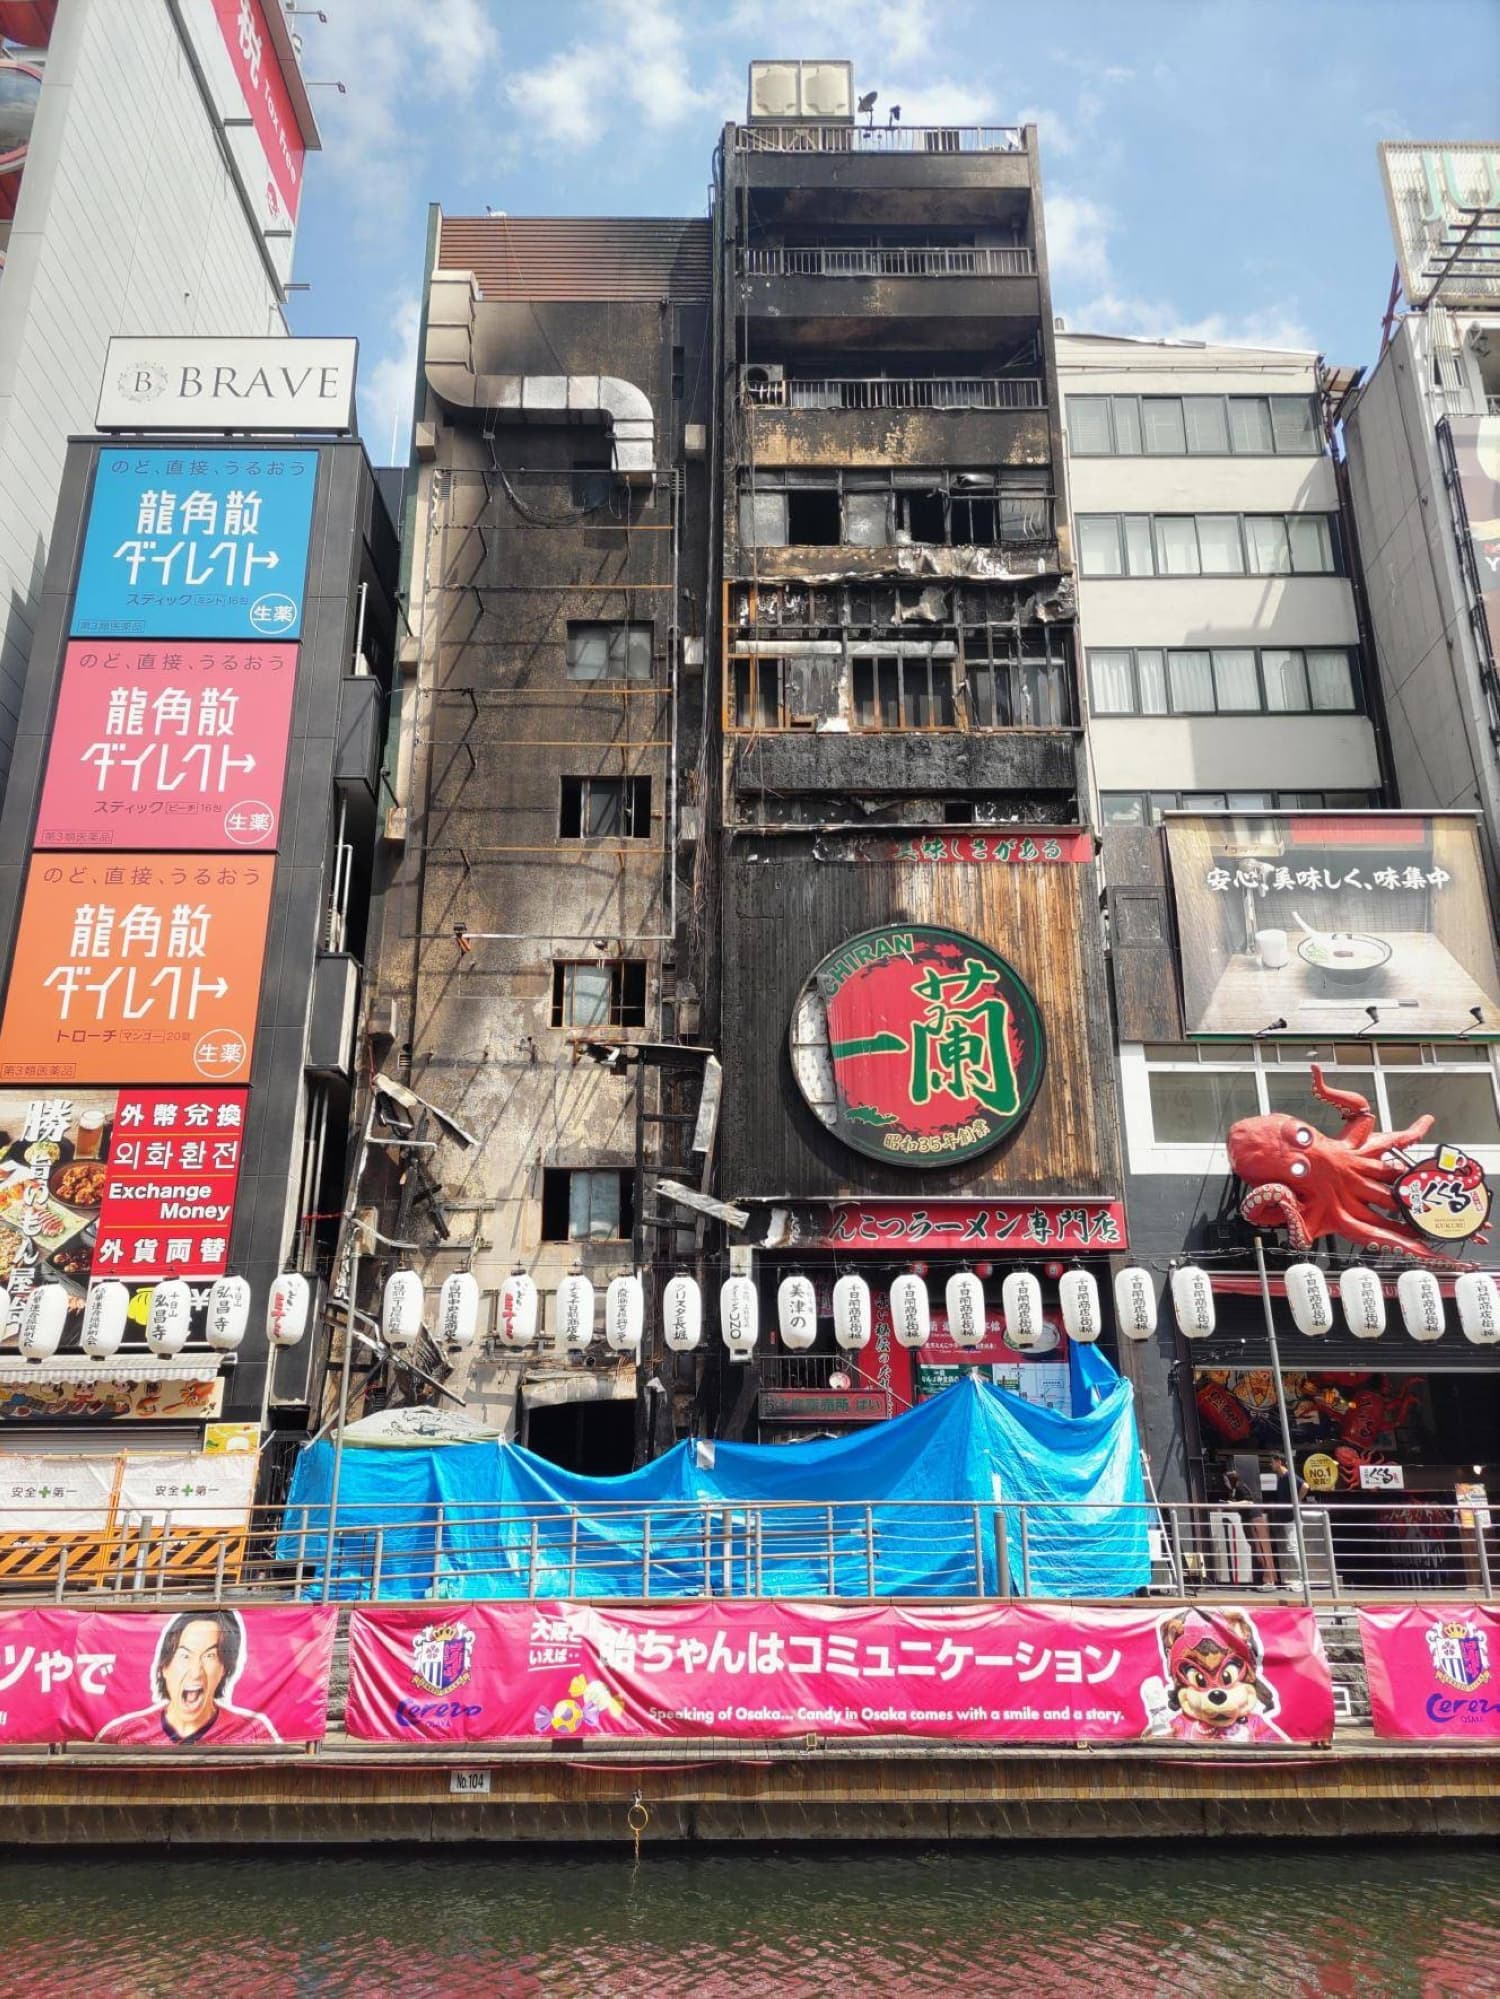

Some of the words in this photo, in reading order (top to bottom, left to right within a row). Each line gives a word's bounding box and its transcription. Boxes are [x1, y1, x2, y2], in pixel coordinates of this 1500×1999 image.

[179, 366, 340, 399] BRAVE
[111, 459, 305, 476] のど、直接、うるおう
[137, 490, 263, 537] 龍角散
[113, 540, 280, 587] ダイレクト
[127, 593, 193, 606] スティック
[252, 605, 294, 623] 生薬
[79, 652, 285, 672] のど、直接、うるおう
[105, 686, 240, 737] 龍角散
[80, 743, 256, 793] ダイレクト
[93, 801, 165, 814] スティック
[228, 813, 271, 832] 生薬
[44, 865, 261, 887] のど、直接、うるおう
[1207, 866, 1451, 892] 安心、美味しく、味集中
[70, 903, 212, 959] 龍角散
[43, 966, 229, 1020] ダイレクト
[57, 1029, 118, 1043] トローチ
[830, 957, 1021, 1118] 一蘭
[197, 1043, 242, 1063] 生薬
[120, 1103, 242, 1127] 外幣兌換
[883, 1118, 990, 1153] 昭和35年創業
[113, 1141, 238, 1170] 외화환전
[108, 1183, 213, 1201] Exchange
[160, 1202, 231, 1220] Money
[98, 1237, 227, 1264] 外貨両替
[151, 1294, 169, 1342] 弘昌寺
[214, 1285, 234, 1333] 弘昌寺
[789, 1282, 807, 1329] 美津の
[1309, 1467, 1332, 1478] NO.1
[11, 1486, 37, 1498] 安全
[52, 1486, 78, 1498] 第一
[154, 1485, 179, 1497] 安全
[195, 1485, 220, 1497] 第一
[530, 1619, 581, 1643] 大阪と
[600, 1628, 1122, 1686] 飴ちゃんはコミュニケーション
[394, 1699, 483, 1727] Cerezo
[649, 1706, 714, 1724] Speaking
[718, 1706, 733, 1720] of
[735, 1706, 793, 1720] Osaka...
[797, 1706, 841, 1723] Candy
[845, 1706, 858, 1720] in
[861, 1706, 907, 1720] Osaka
[910, 1708, 953, 1721] comes
[956, 1706, 987, 1721] with
[990, 1710, 1000, 1720] a
[1003, 1706, 1040, 1721] smile
[1043, 1706, 1071, 1721] and
[1073, 1710, 1082, 1720] a
[1085, 1708, 1125, 1724] story.
[1426, 1692, 1500, 1723] Cerez
